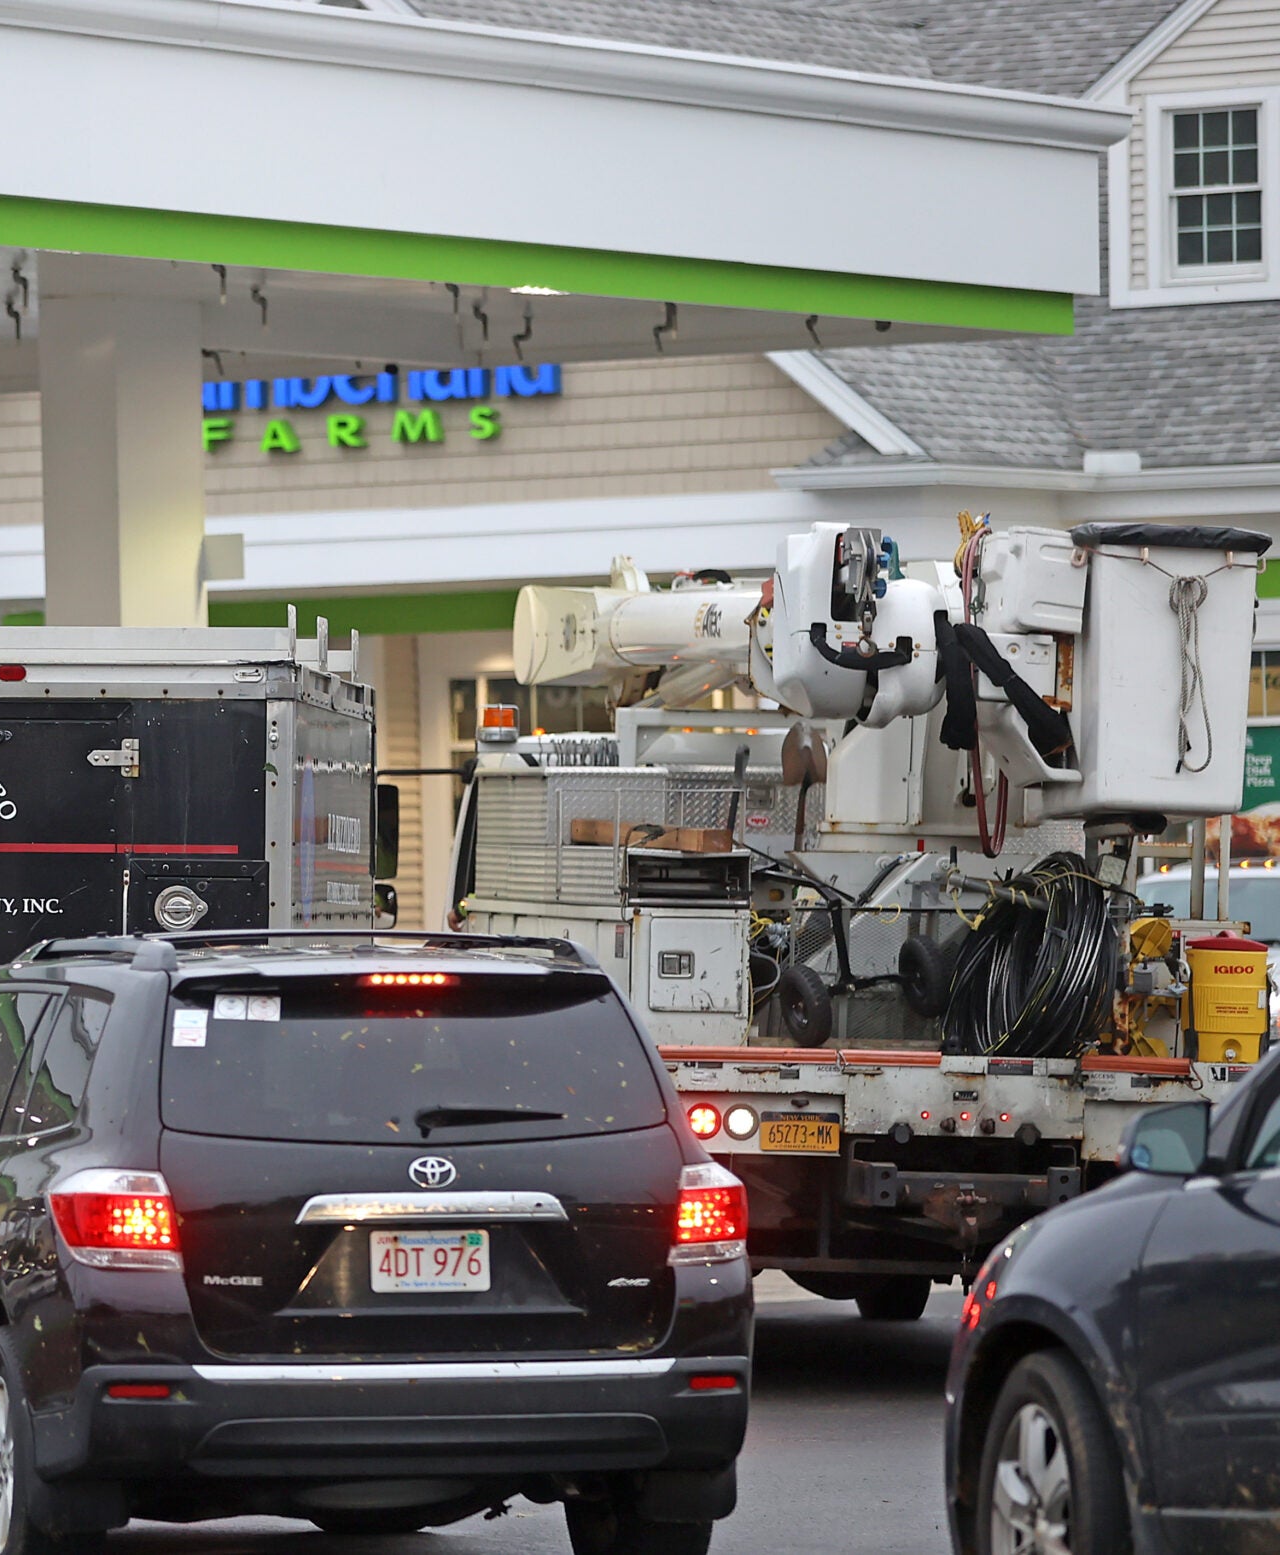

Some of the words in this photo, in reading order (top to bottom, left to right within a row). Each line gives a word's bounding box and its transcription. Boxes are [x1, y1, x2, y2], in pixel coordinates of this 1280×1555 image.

[202, 405, 501, 453] FARMS
[22, 898, 64, 914] INC.
[1214, 965, 1254, 974] IGLOO
[768, 1124, 808, 1144] 65273
[379, 1247, 425, 1277] 4DT
[433, 1247, 482, 1277] 976
[203, 1275, 263, 1286] McGEE
